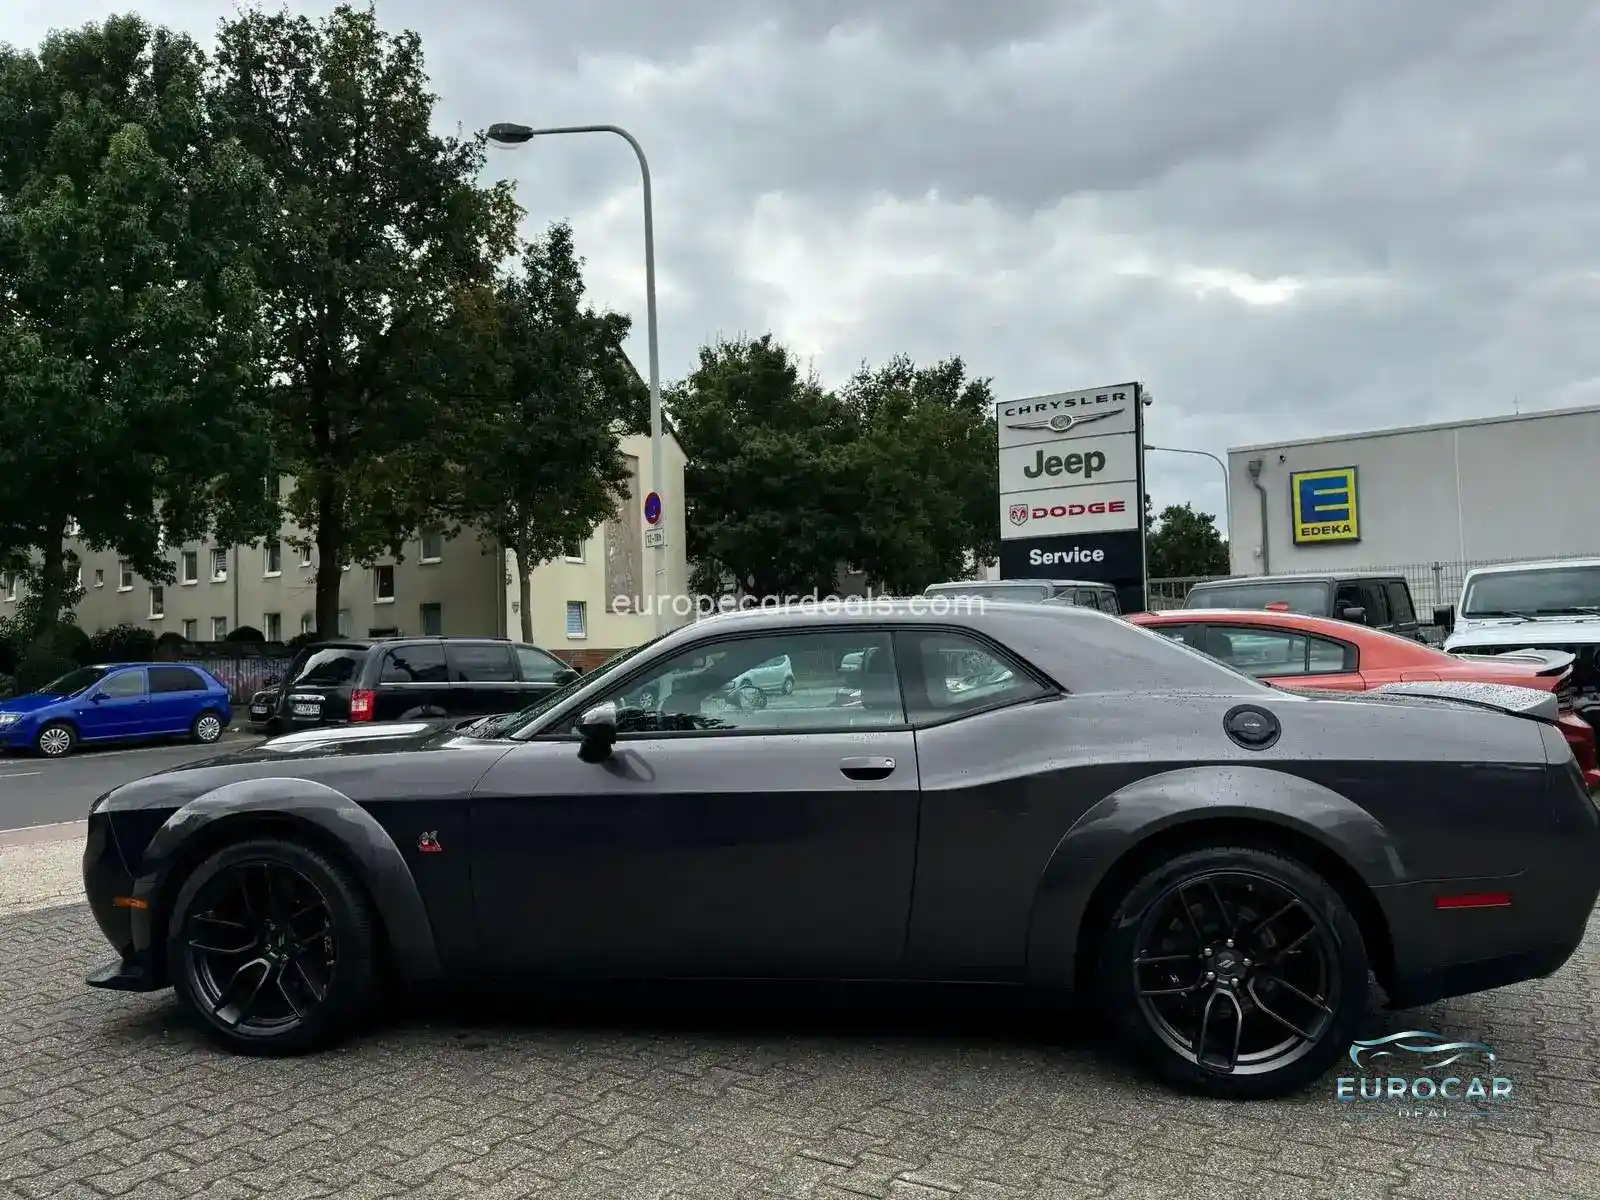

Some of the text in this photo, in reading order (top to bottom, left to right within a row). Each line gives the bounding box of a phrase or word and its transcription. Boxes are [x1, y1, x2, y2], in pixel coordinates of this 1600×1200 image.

[1004, 392, 1127, 417] CHRYSLER
[1023, 450, 1106, 479] Jeep
[1032, 501, 1126, 519] DODGE
[1301, 524, 1352, 536] EDEKA
[1029, 547, 1105, 565] Service
